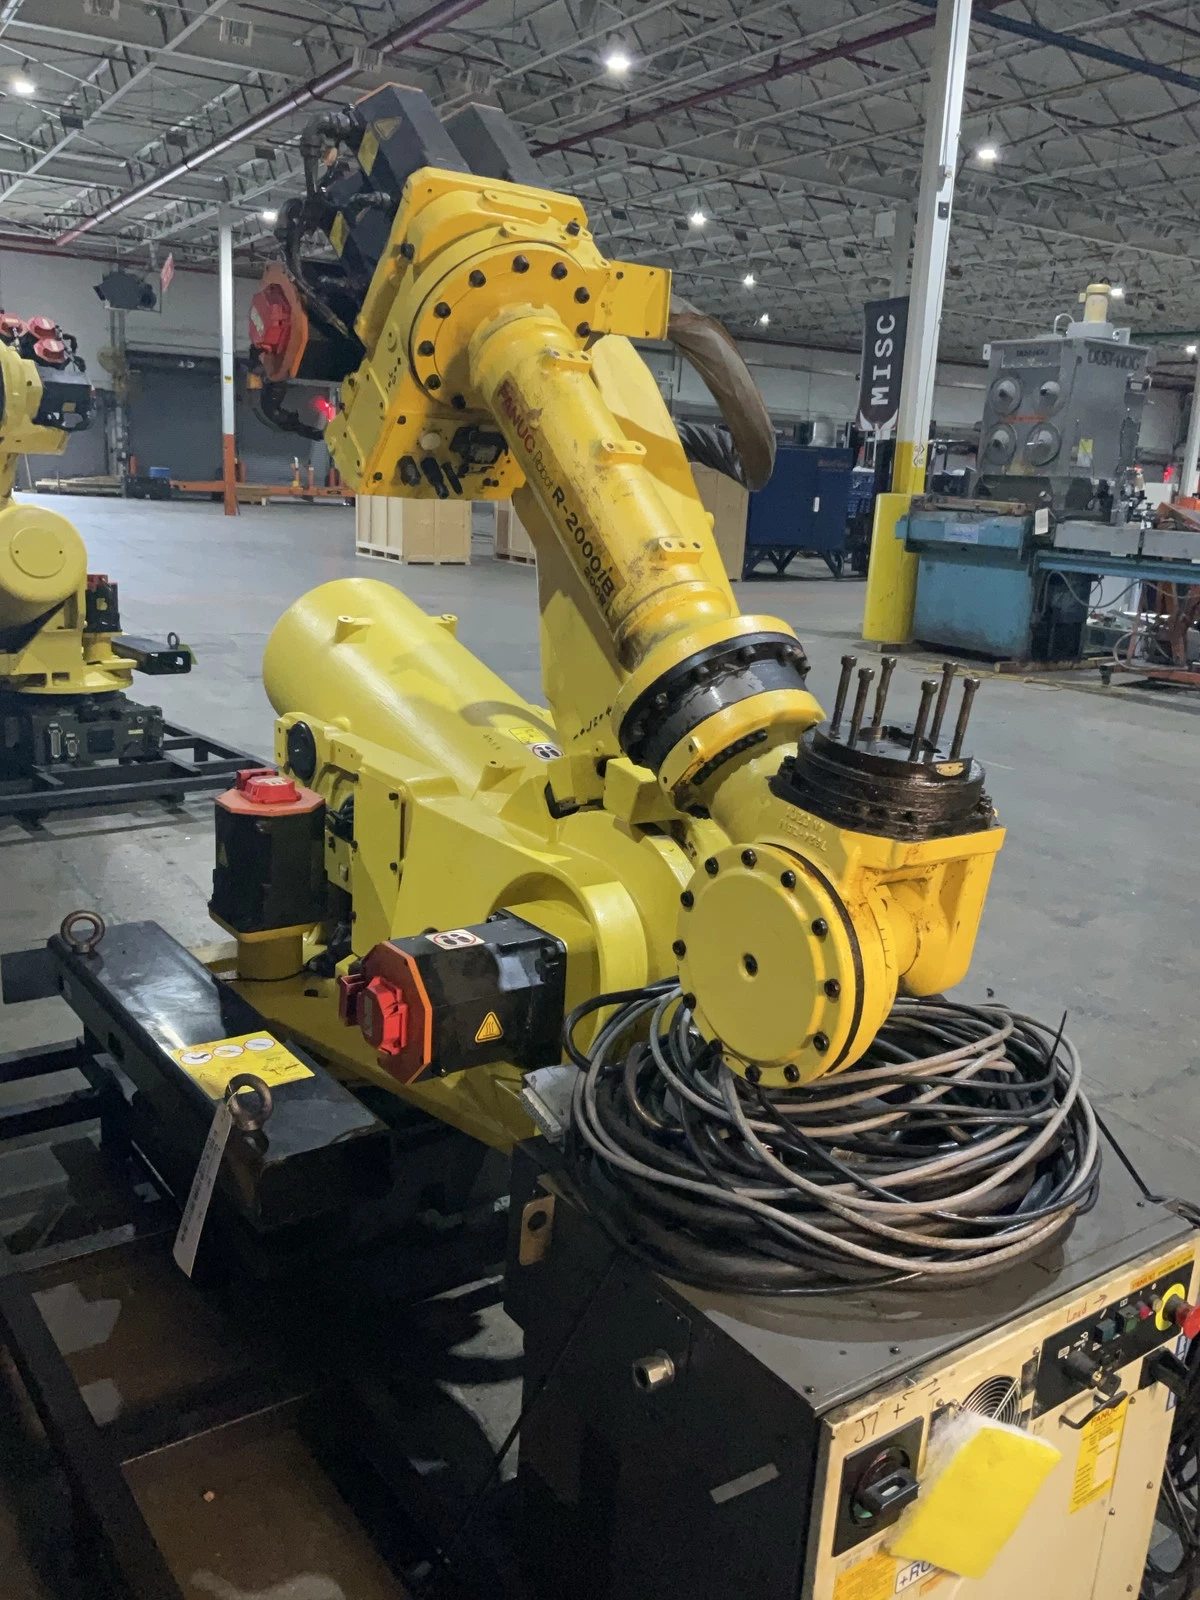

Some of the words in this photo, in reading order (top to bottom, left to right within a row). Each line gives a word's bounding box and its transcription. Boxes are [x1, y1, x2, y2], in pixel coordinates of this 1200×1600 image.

[870, 314, 896, 406] MISC
[498, 379, 536, 454] FANUC
[533, 450, 554, 490] Robot
